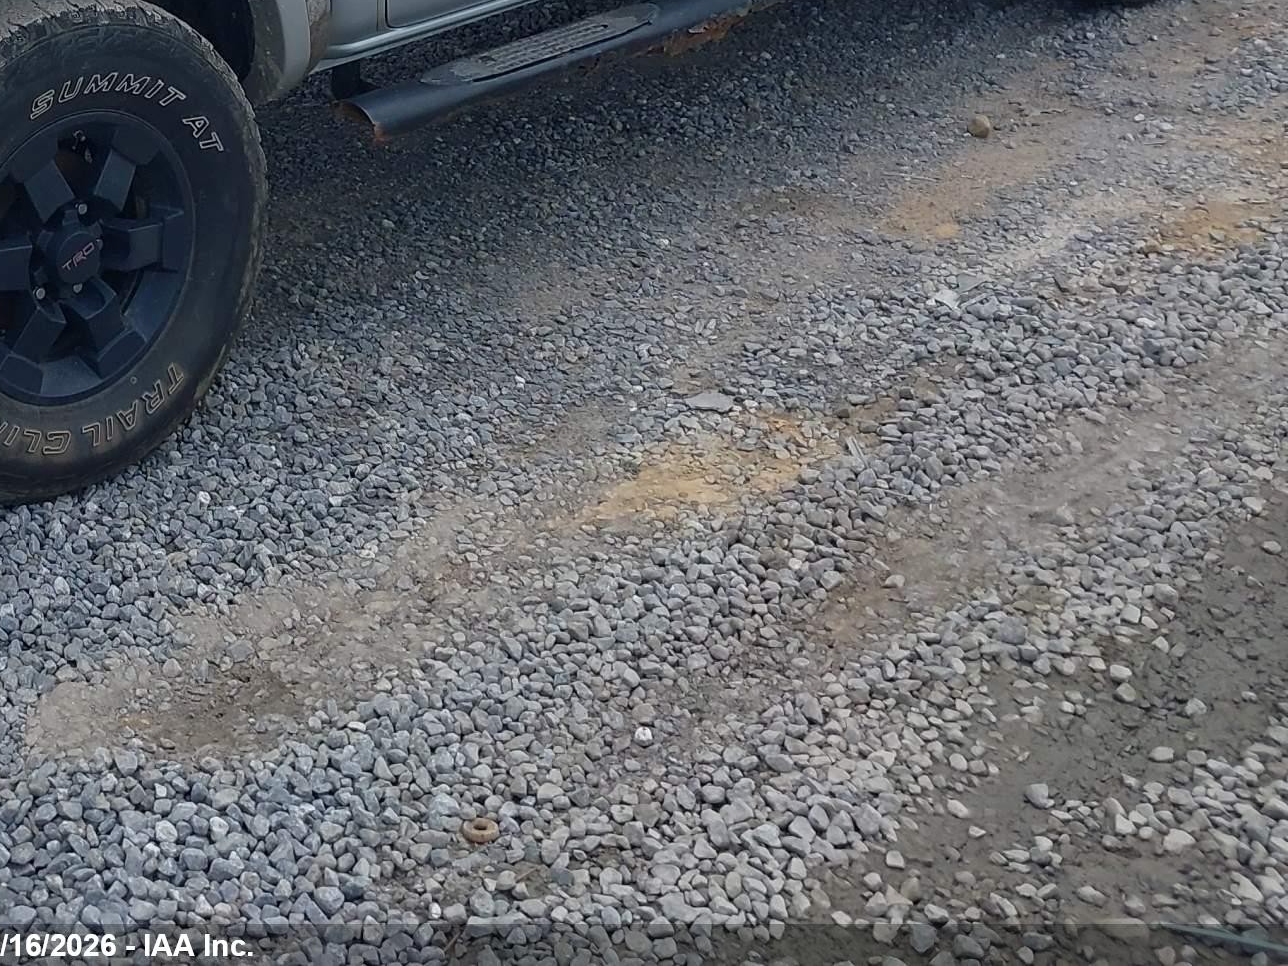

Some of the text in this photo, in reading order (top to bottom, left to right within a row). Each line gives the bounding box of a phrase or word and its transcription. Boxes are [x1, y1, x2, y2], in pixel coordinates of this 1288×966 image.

[30, 72, 225, 153] SUMMIT AT
[62, 242, 96, 271] TRD
[82, 362, 187, 448] TRAIL
